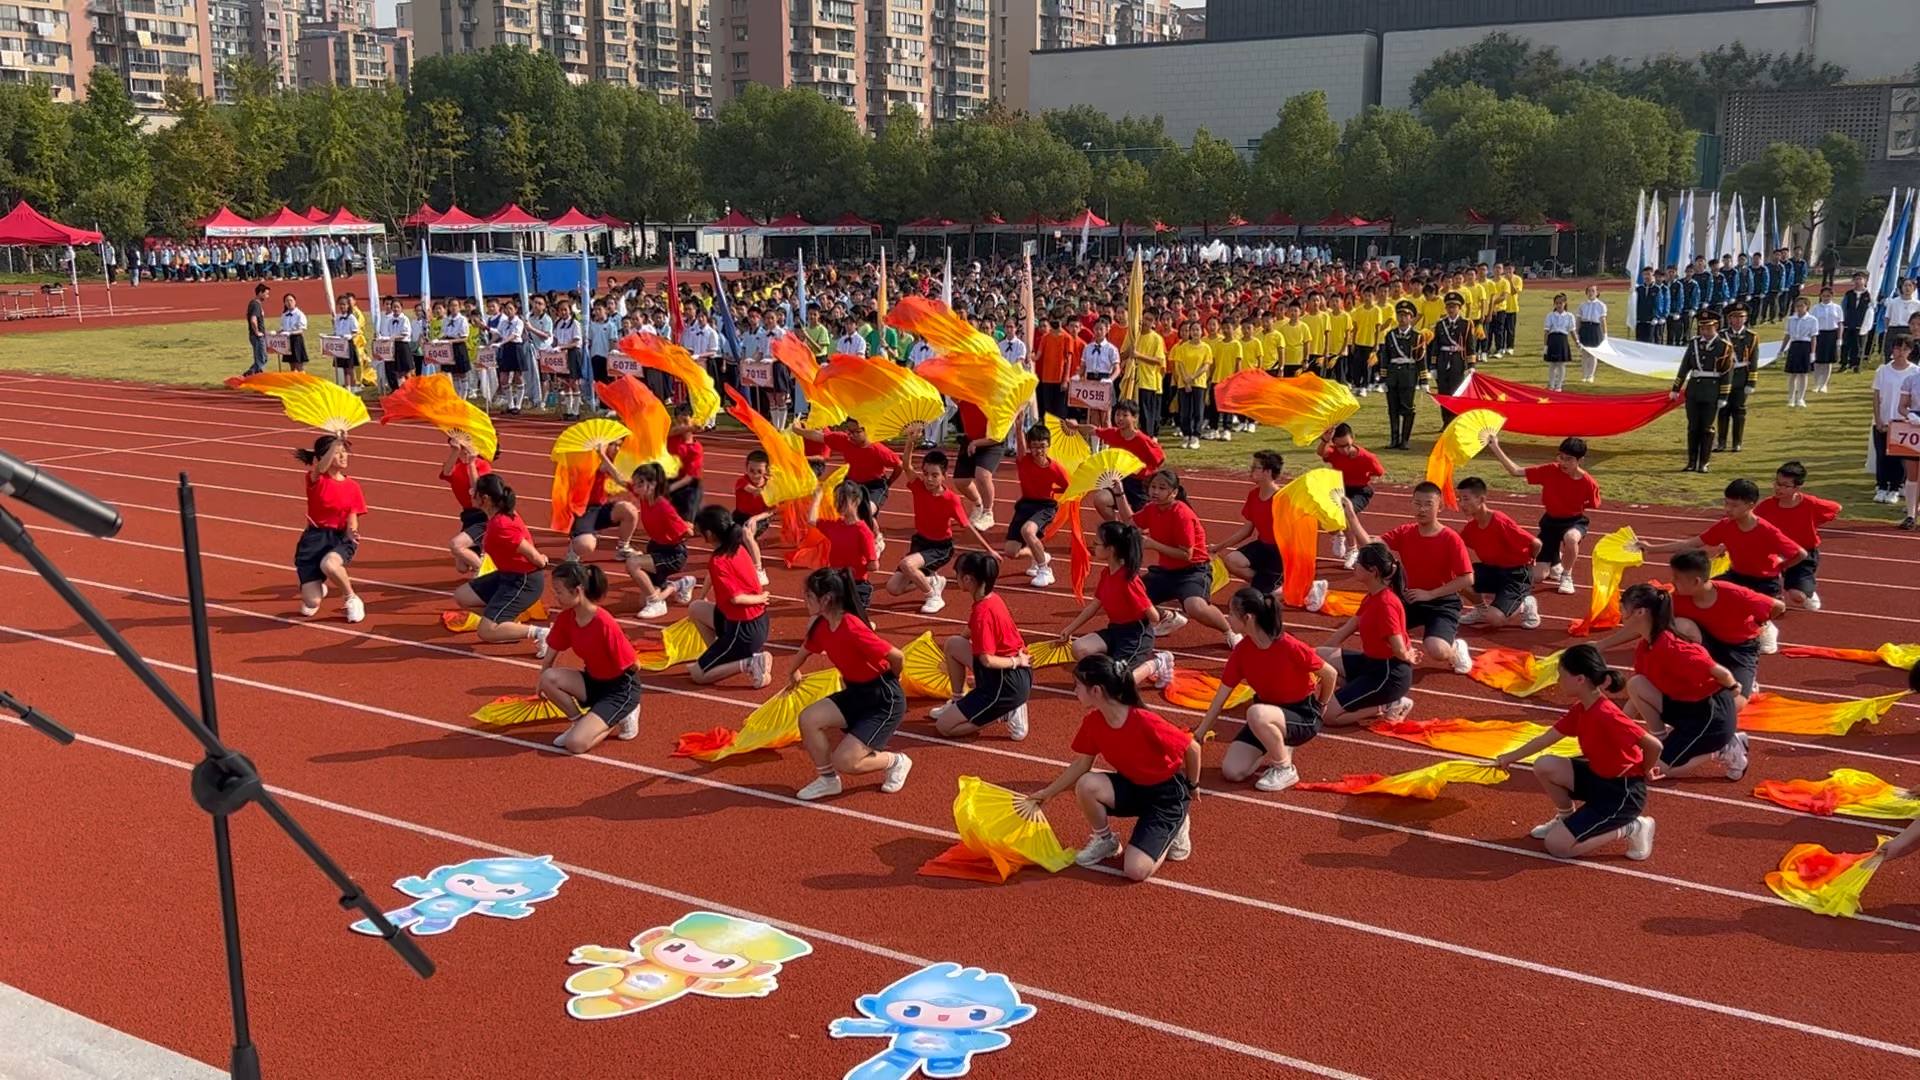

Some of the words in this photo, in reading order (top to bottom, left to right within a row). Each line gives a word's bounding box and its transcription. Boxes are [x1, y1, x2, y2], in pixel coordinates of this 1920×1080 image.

[428, 349, 449, 359] 604班
[544, 357, 564, 367] 606班
[612, 360, 638, 371] 607班
[745, 368, 768, 380] 701班
[1075, 387, 1105, 402] 705班
